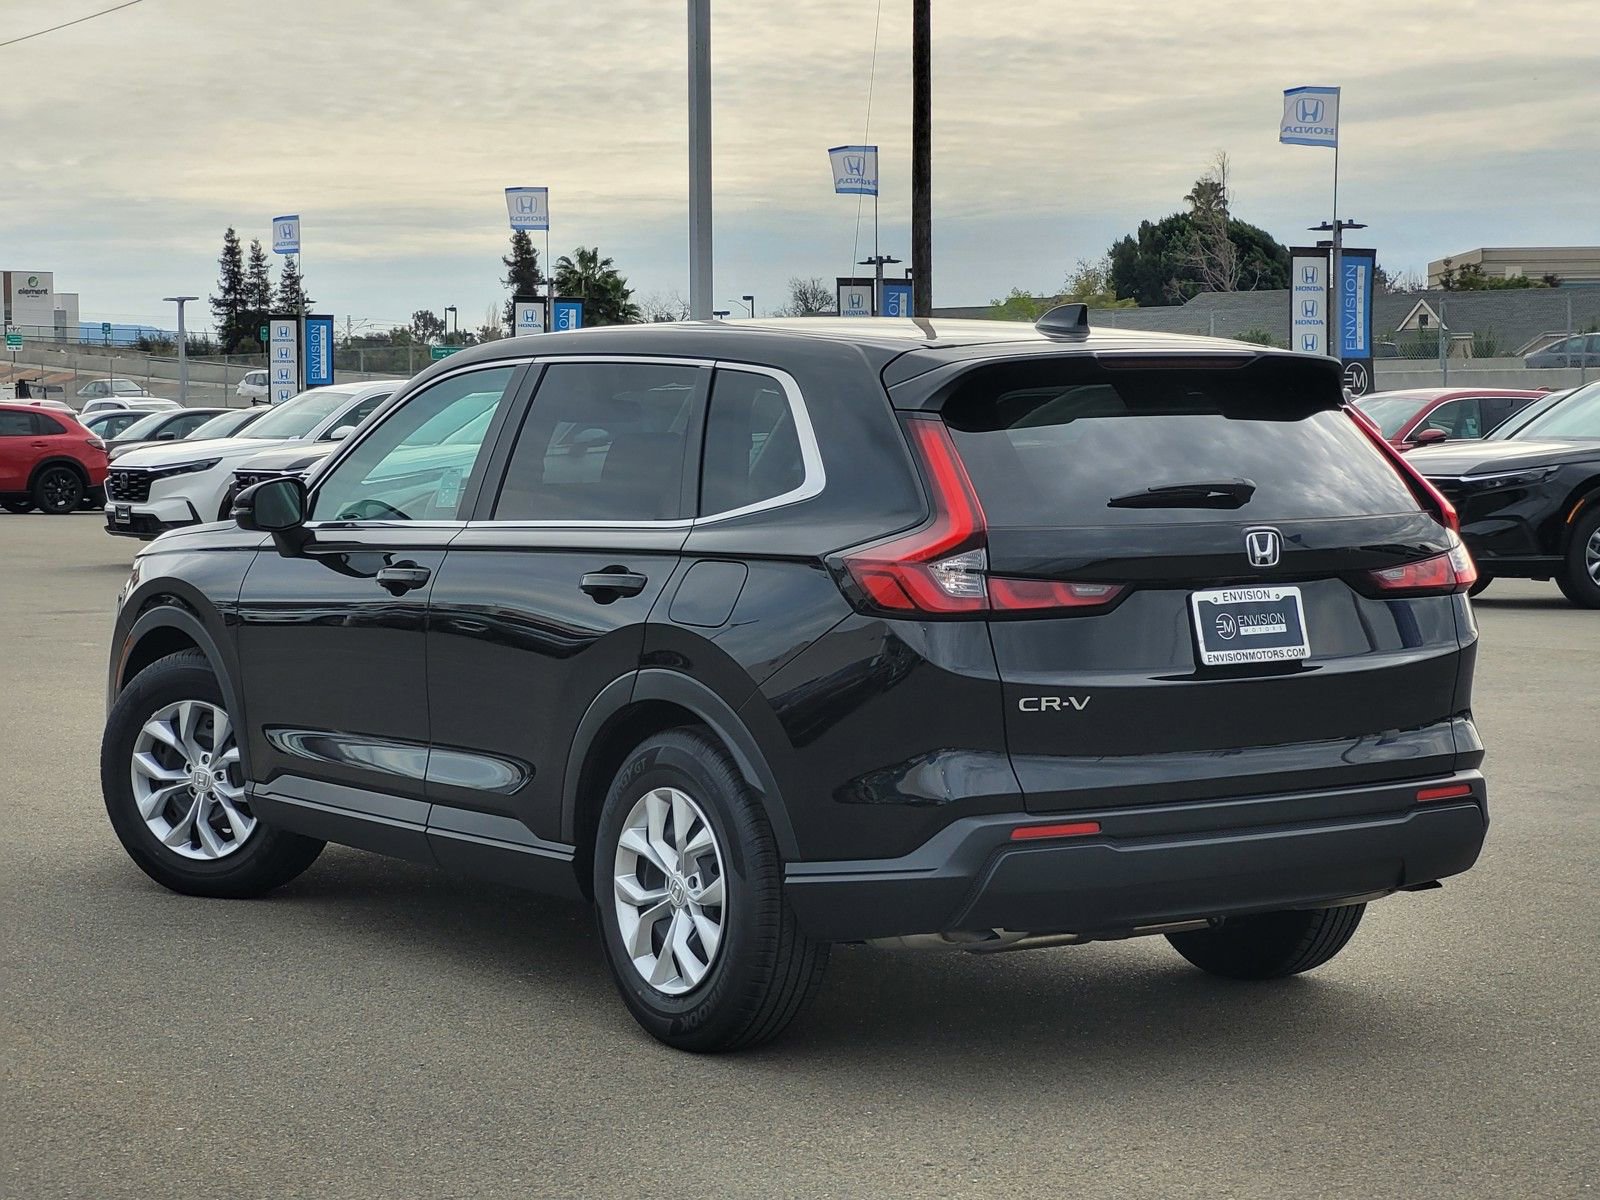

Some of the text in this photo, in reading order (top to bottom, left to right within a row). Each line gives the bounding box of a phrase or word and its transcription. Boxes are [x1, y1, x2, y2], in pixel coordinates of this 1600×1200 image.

[18, 287, 48, 295] element
[1345, 264, 1357, 350] ENVISION
[311, 324, 320, 379] ENVISION
[1222, 590, 1271, 602] ENVISION
[1237, 612, 1286, 627] ENVISION
[1207, 648, 1306, 663] ENVISIONMOTORS.COM
[1018, 696, 1091, 711] CR-V
